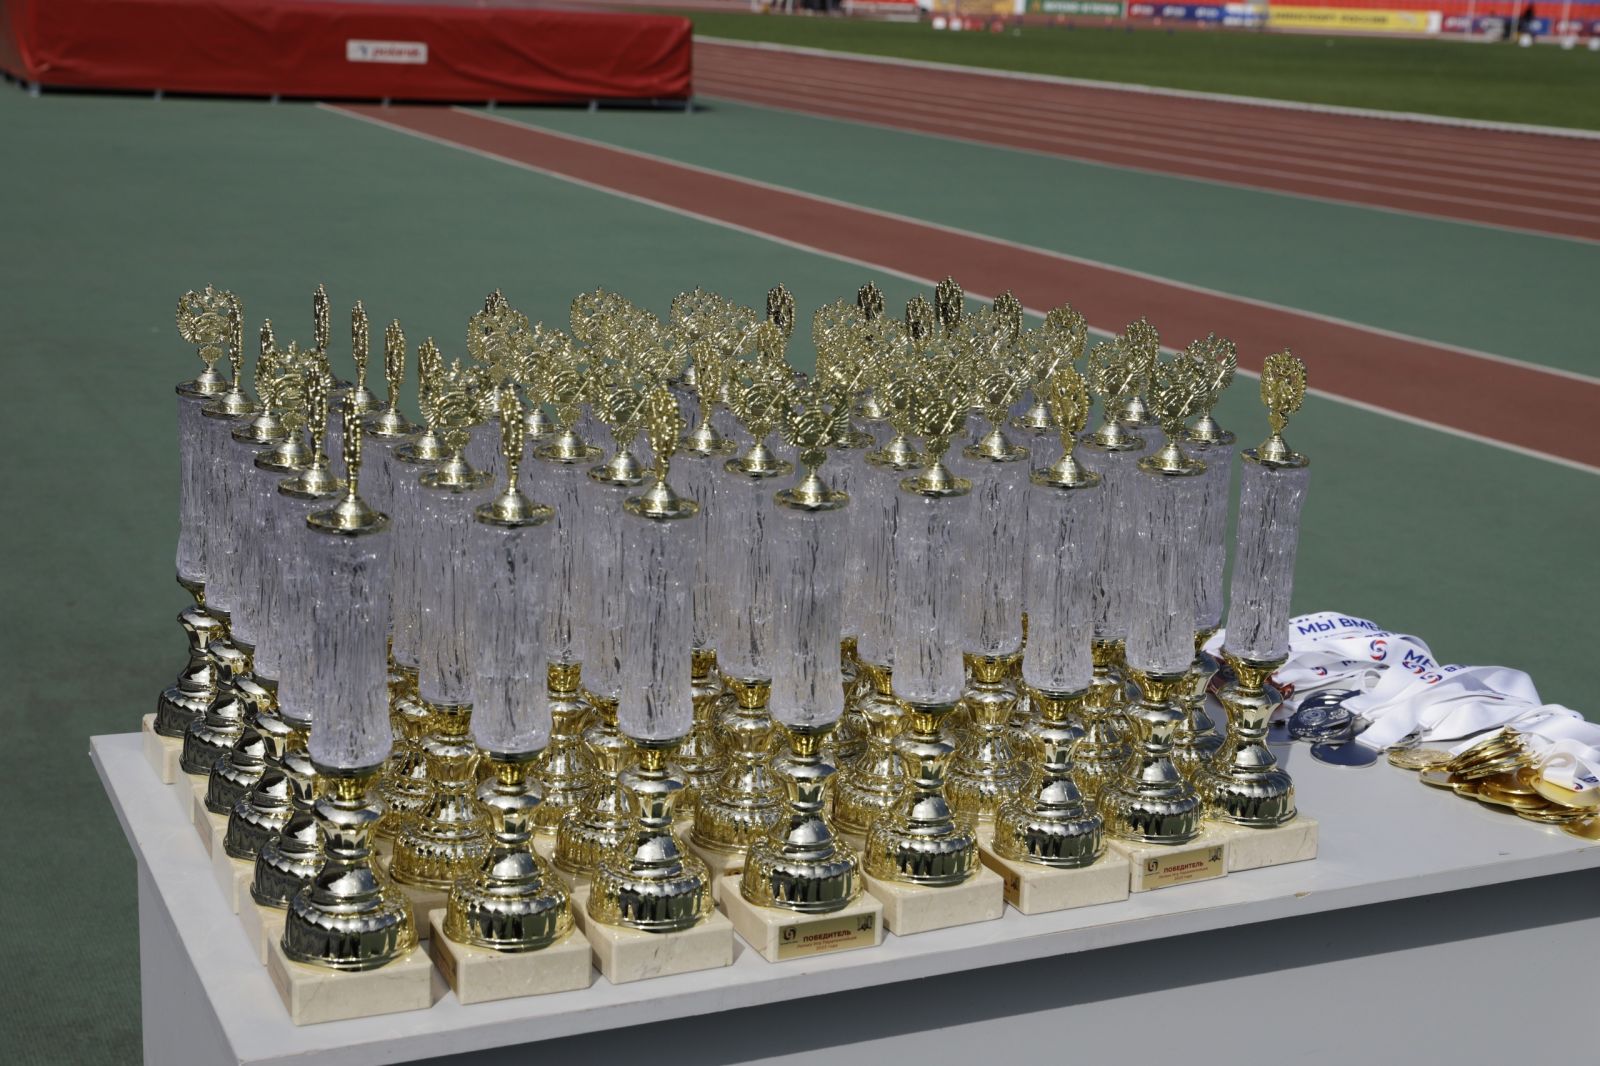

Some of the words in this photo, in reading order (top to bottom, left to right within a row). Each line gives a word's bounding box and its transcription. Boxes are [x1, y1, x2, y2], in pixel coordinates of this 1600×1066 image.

[1298, 619, 1336, 635] МЫ
[1163, 861, 1204, 873] ПОБЕДИТЕЛЬ
[803, 929, 852, 942] ПОБЕДИТЕЛЬ
